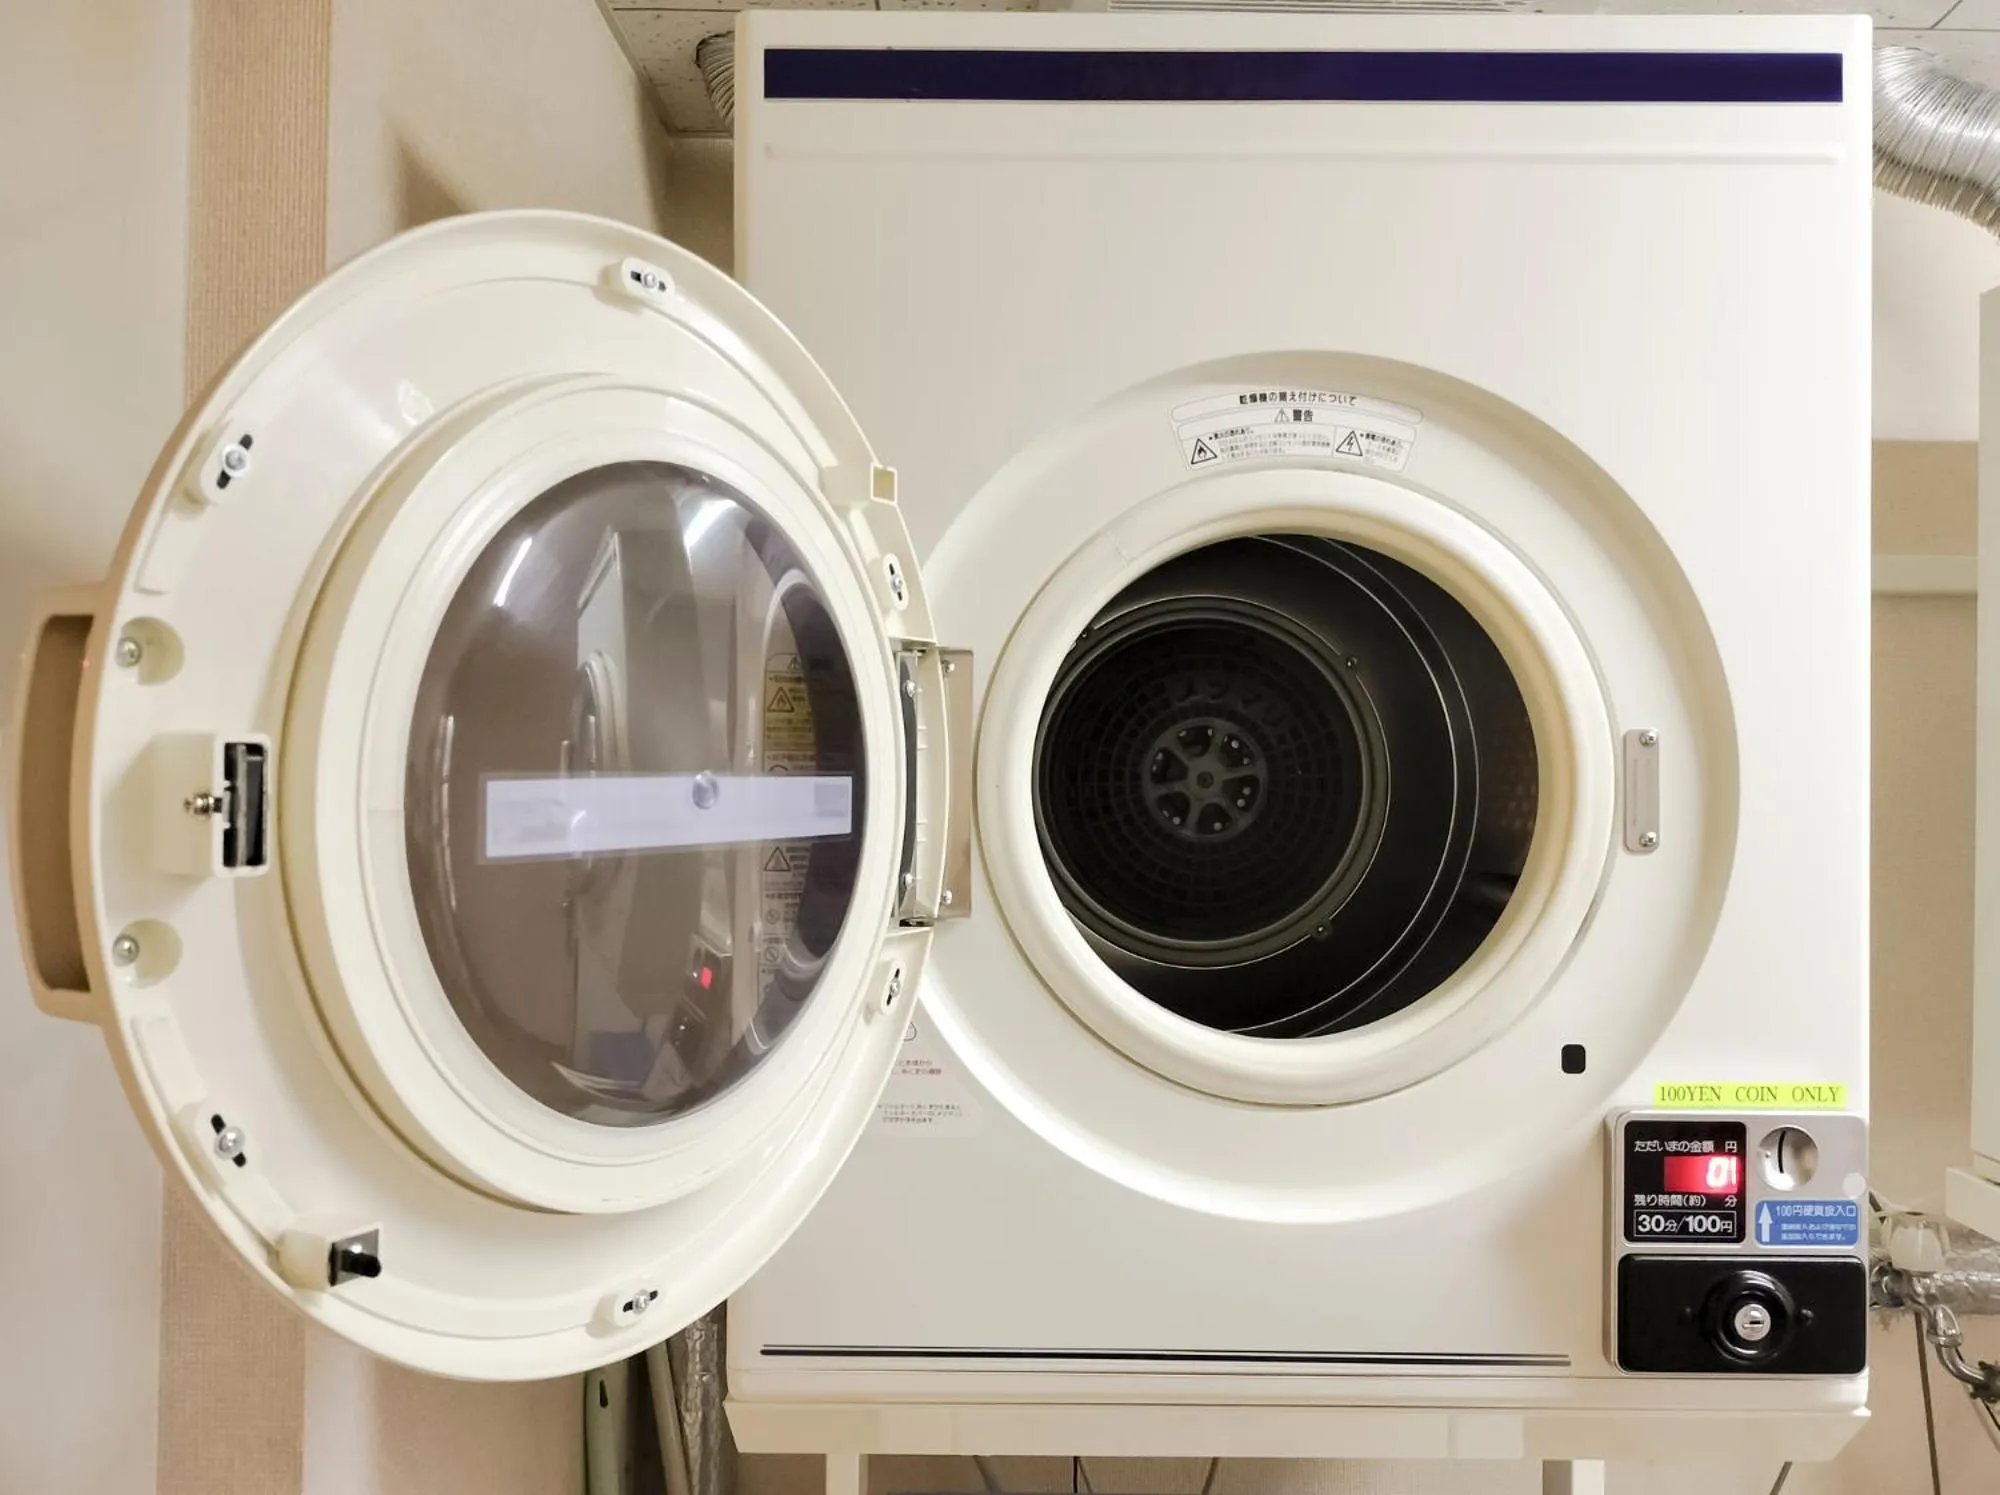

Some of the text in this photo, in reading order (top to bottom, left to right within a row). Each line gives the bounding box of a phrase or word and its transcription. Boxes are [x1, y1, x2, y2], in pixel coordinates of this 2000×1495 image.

[1660, 1086, 1840, 1102] 100YEN COIN ONLY
[1634, 1140, 1737, 1152] ただいまの金額 円
[1724, 1195, 1737, 1207] 分
